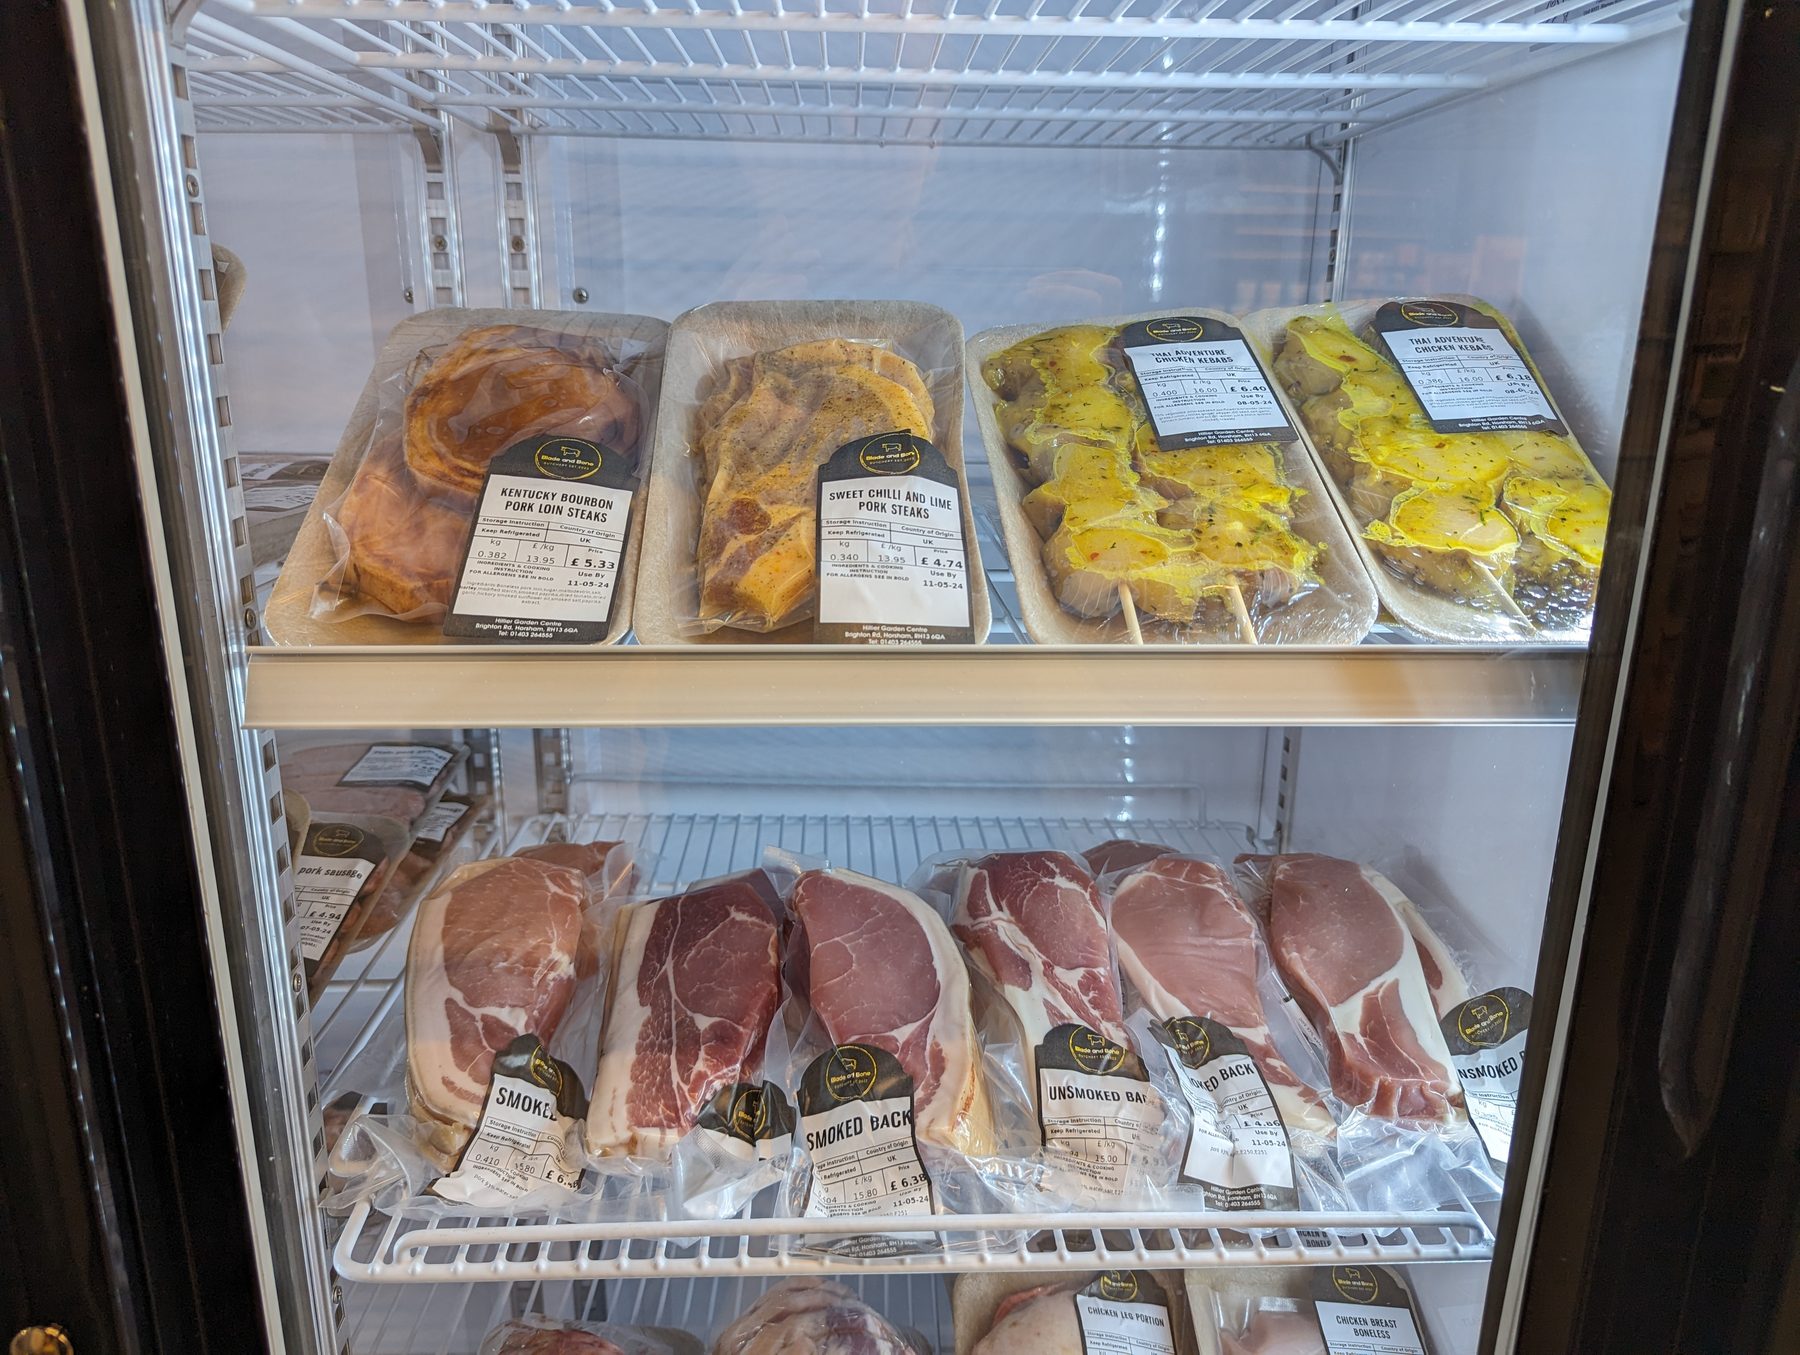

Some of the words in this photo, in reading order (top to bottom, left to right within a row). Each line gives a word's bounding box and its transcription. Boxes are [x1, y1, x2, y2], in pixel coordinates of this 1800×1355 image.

[1408, 337, 1431, 346] THAI
[1174, 349, 1227, 357] ADVENTURE
[1415, 345, 1456, 354] CHICKEN
[1155, 356, 1196, 364] CHICKEN
[1506, 373, 1532, 381] 6.18
[576, 459, 594, 467] Bone
[500, 487, 558, 501] KENTUCKY
[560, 493, 614, 510] BOURBON
[829, 489, 865, 501] SWEET
[868, 489, 901, 501] CHILLI
[905, 490, 926, 504] AND
[929, 495, 953, 511] LIME
[505, 501, 535, 513] PORK
[538, 504, 564, 516] LOIN
[567, 508, 608, 523] STEAKS
[858, 501, 888, 514] PORK
[891, 504, 930, 520] STEAKS
[482, 517, 508, 525] Storage
[509, 519, 545, 528] Instruction
[852, 519, 887, 529] Instruction
[499, 528, 541, 538] Refrigerated
[559, 524, 585, 534] Country
[595, 530, 616, 539] Origin
[845, 530, 885, 538] Refrigerated
[900, 525, 926, 535] Country
[934, 530, 954, 538] Origin
[490, 539, 501, 547] kg
[477, 551, 507, 560] 0.382
[526, 555, 556, 565] 13.95
[829, 553, 859, 561] 0.340
[878, 554, 906, 564] 13.95
[477, 560, 516, 569] INGREDIENTS
[570, 558, 579, 567] £
[584, 559, 615, 570] 5.33
[920, 556, 929, 566] £
[933, 558, 963, 569] 4.74
[493, 566, 534, 575] INSTRUCTION
[567, 580, 609, 589] 11-05-24
[922, 580, 963, 590] 11-05-24
[475, 622, 502, 632] Brighton
[844, 631, 871, 639] Brighton
[298, 866, 323, 875] pork
[324, 869, 363, 880] sausage
[317, 912, 342, 920] 4.94
[1465, 1023, 1481, 1035] Blade
[1219, 1063, 1255, 1082] BACK
[1457, 1056, 1518, 1080] NSMOKED
[831, 1074, 847, 1083] Blade
[855, 1070, 871, 1078] Bone
[1049, 1085, 1121, 1102] UNSMOKED
[1240, 1093, 1245, 1101] of
[1245, 1089, 1262, 1099] Origin
[489, 1119, 512, 1130] Storage
[1114, 1118, 1135, 1128] Country
[806, 1116, 863, 1151] SMOKED
[870, 1108, 911, 1131] BACK
[489, 1144, 500, 1152] kg
[866, 1145, 886, 1156] Country
[892, 1139, 909, 1149] Origin
[1251, 1139, 1287, 1148] 11-05-24
[475, 1153, 500, 1166] 0.410
[826, 1154, 856, 1167] Instruction
[887, 1154, 897, 1162] UK
[1095, 1154, 1118, 1163] 15.00
[545, 1169, 555, 1180] £
[823, 1167, 857, 1180] Refrigerated
[855, 1177, 861, 1185] £
[861, 1175, 873, 1185] /kg
[890, 1181, 897, 1191] £
[901, 1173, 927, 1188] 6.38
[853, 1187, 878, 1200] 15.80
[1225, 1188, 1246, 1196] Garden
[893, 1194, 929, 1208] 11-05-24
[1087, 1306, 1119, 1319] CHICKEN
[1120, 1311, 1134, 1320] LEG
[1135, 1313, 1165, 1327] PORTION
[1336, 1315, 1369, 1326] CHICKEN
[1371, 1318, 1398, 1328] BREAST
[1353, 1328, 1391, 1339] BONELESS
